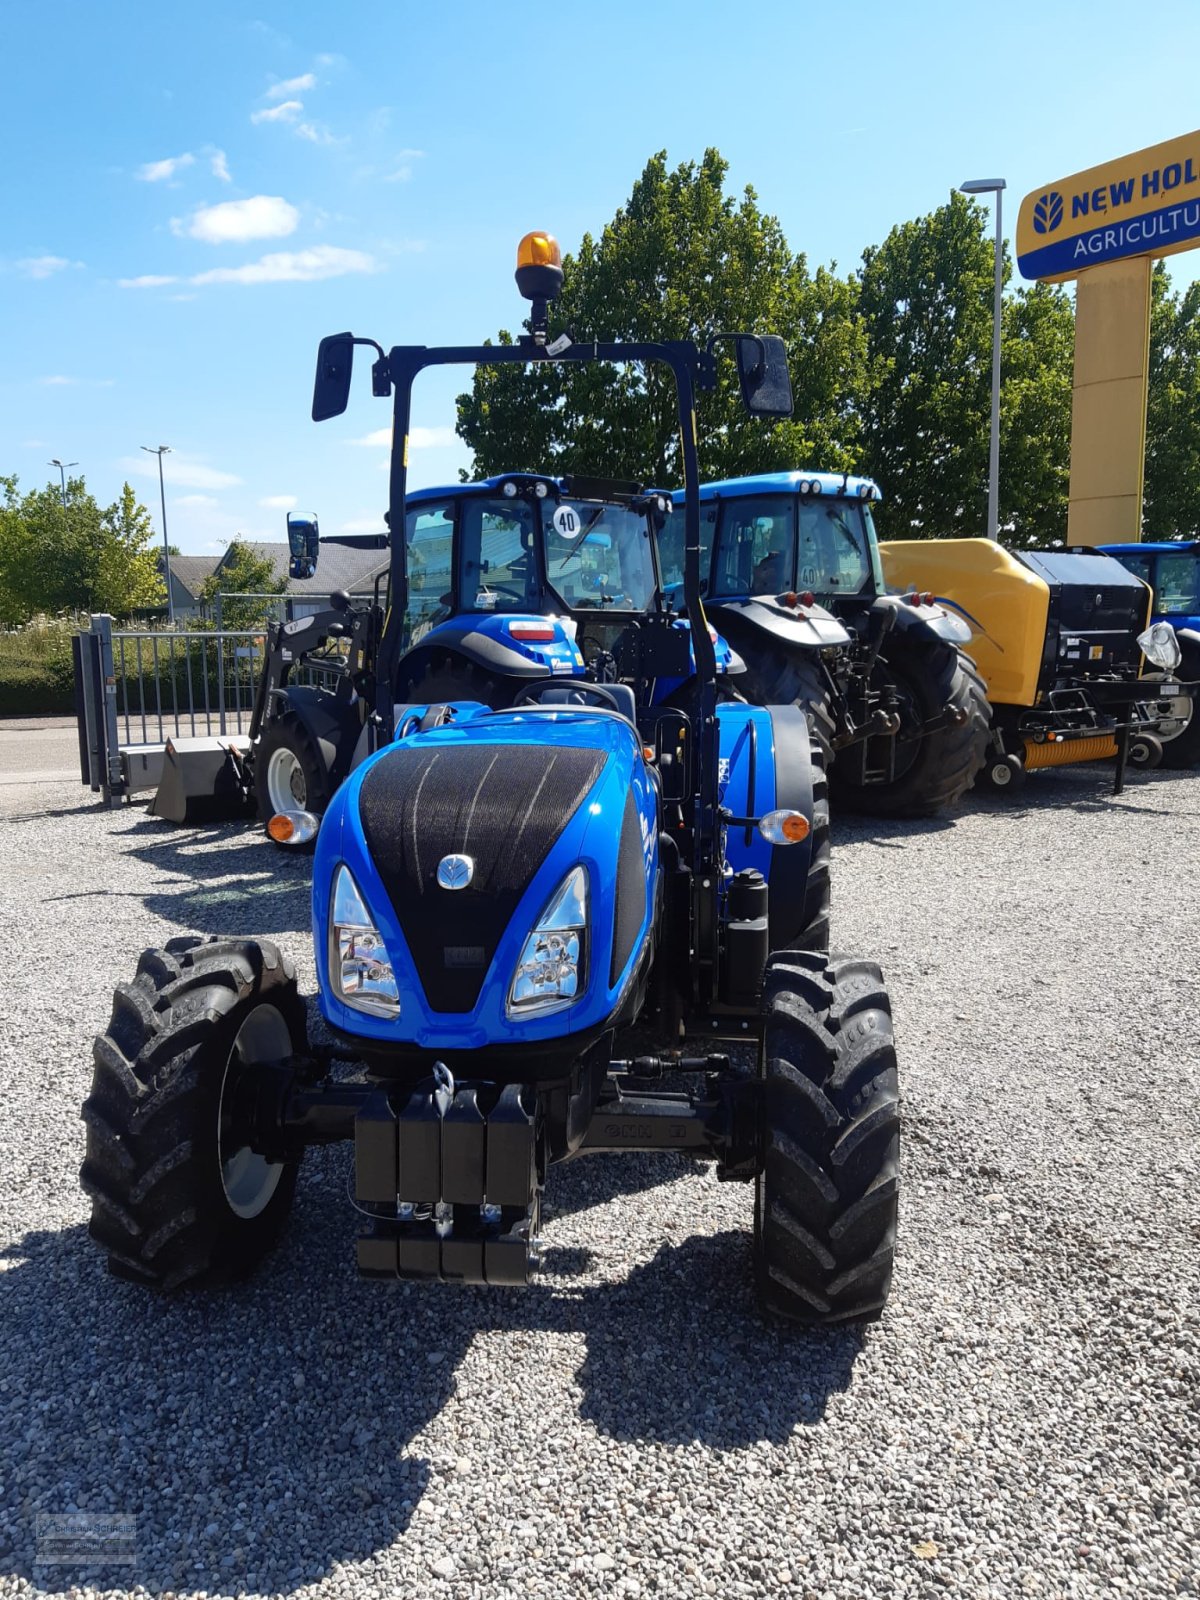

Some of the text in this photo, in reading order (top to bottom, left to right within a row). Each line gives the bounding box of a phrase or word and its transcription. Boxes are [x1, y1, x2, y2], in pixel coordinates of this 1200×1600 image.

[1072, 158, 1200, 219] NEW HOL
[1074, 204, 1200, 258] AGRICULTU
[559, 513, 576, 532] 40
[802, 568, 815, 585] 40
